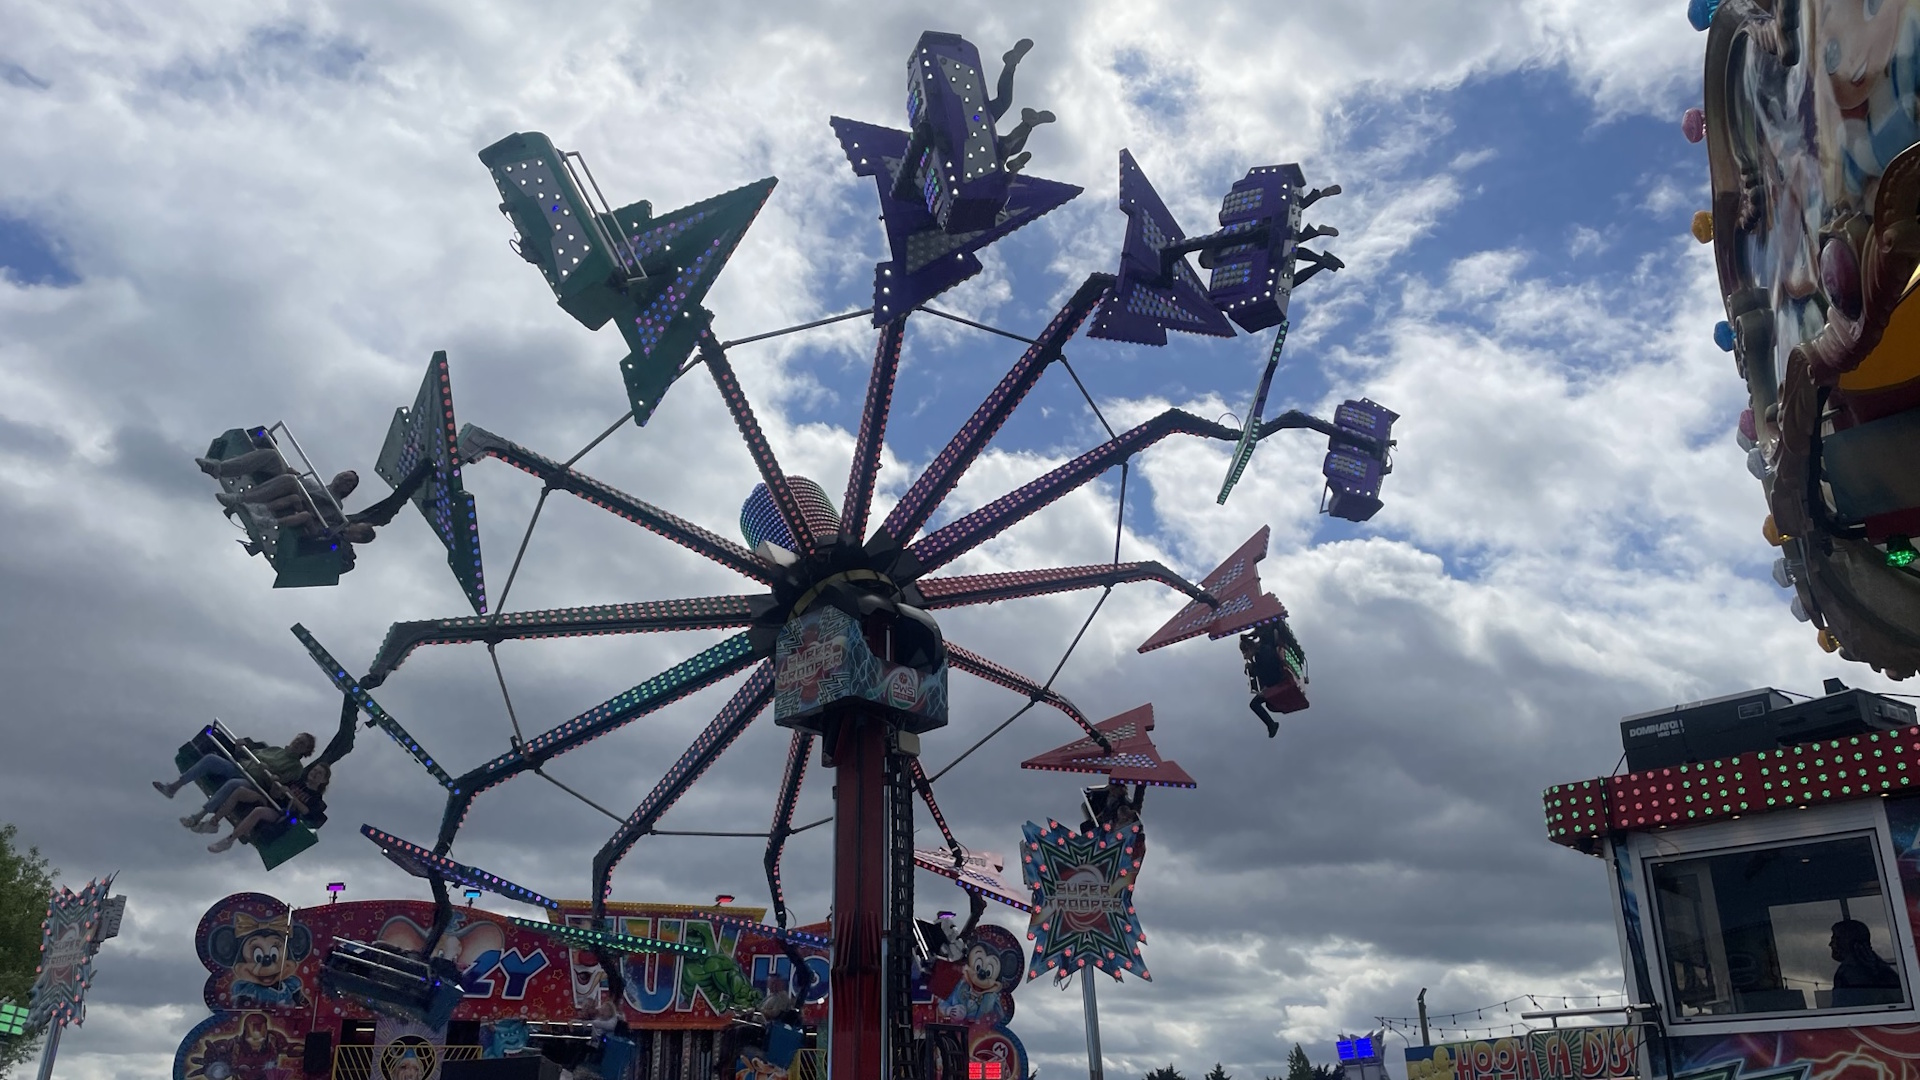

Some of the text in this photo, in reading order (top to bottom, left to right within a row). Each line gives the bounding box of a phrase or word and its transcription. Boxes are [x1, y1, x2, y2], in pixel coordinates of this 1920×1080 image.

[787, 641, 834, 668] SUPER
[779, 651, 843, 686] TROOPER
[893, 682, 914, 696] PWS
[1056, 881, 1110, 898] SUPER
[1044, 897, 1124, 914] TROOPER
[1544, 1035, 1572, 1078] A
